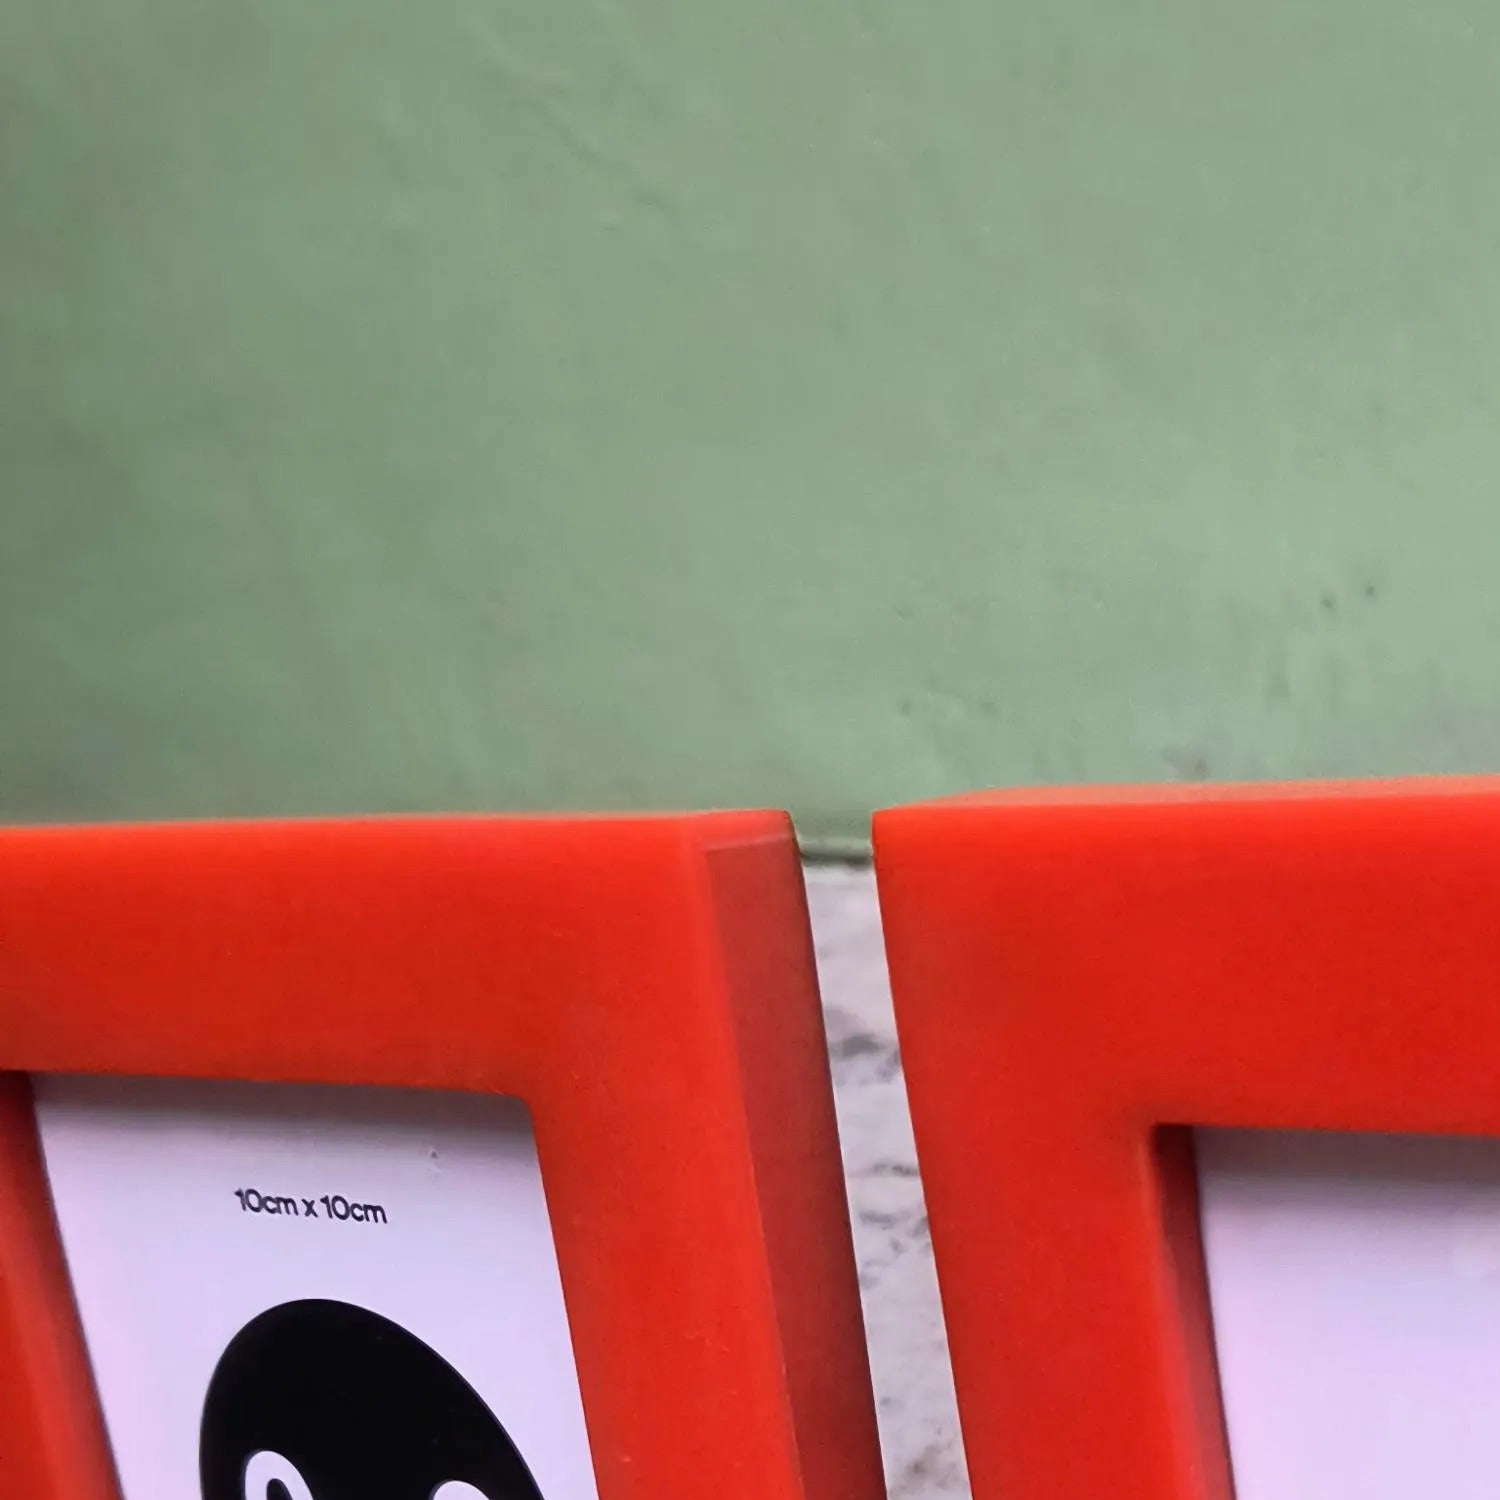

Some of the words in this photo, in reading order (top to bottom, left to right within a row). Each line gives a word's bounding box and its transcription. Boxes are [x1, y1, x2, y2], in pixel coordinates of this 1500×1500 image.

[234, 1188, 299, 1216] 10cm
[301, 1198, 319, 1218] x
[320, 1195, 388, 1224] 10cm
